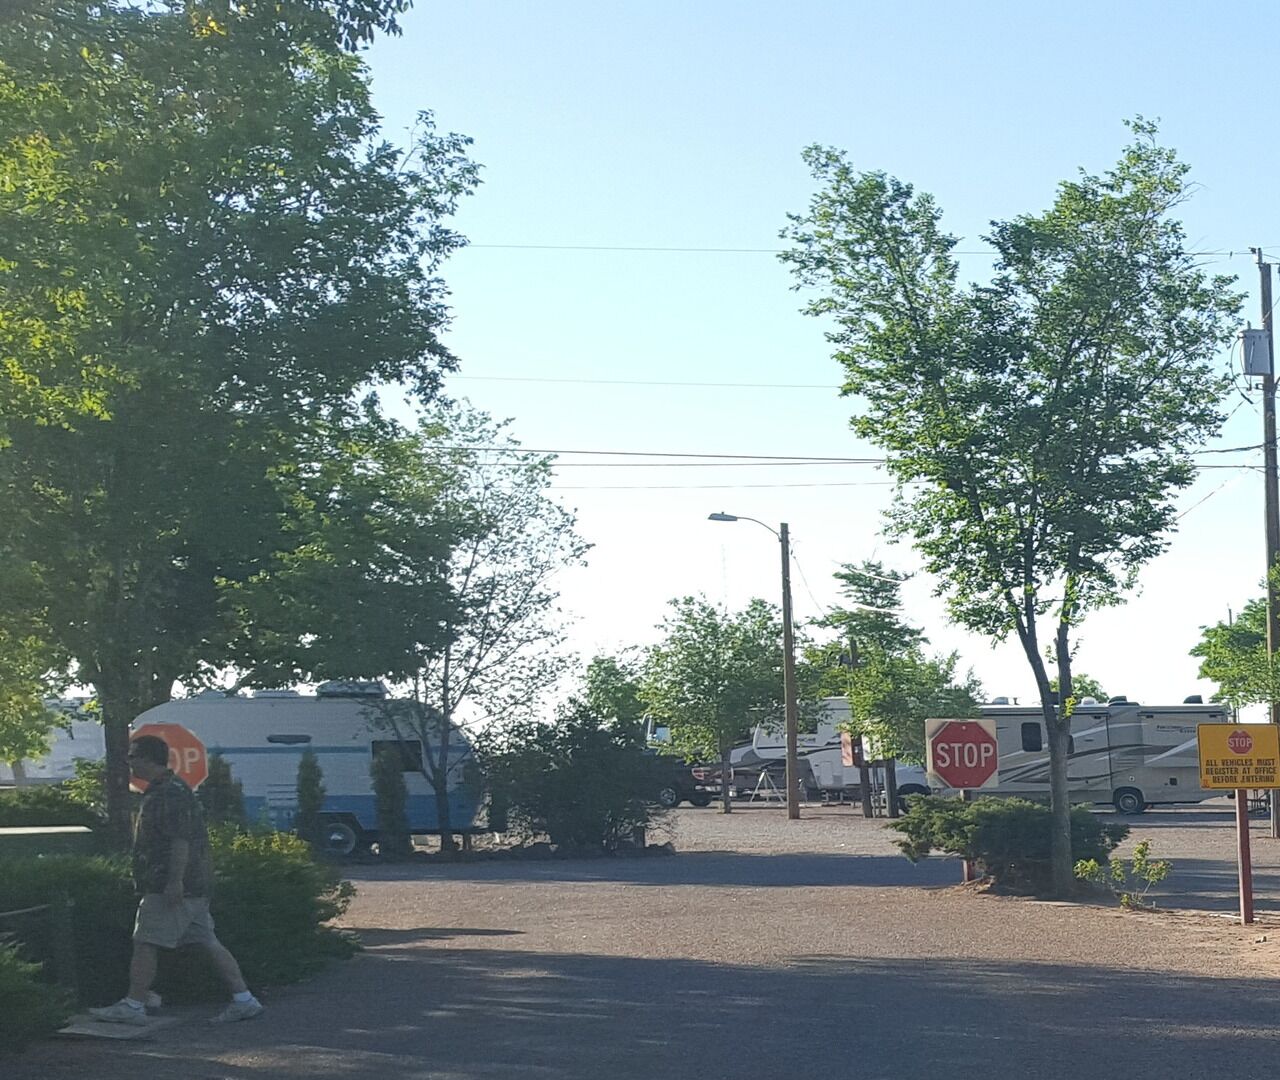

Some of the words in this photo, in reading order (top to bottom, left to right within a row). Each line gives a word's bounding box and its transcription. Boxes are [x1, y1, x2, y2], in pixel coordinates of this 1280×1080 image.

[1229, 737, 1252, 748] STOP
[936, 742, 994, 768] STOP
[167, 747, 200, 774] OP
[1205, 759, 1218, 767] ALL
[1221, 759, 1253, 767] VEHICLES
[1205, 767, 1238, 775] REGISTER
[1242, 767, 1250, 775] AT
[1254, 766, 1277, 775] OFFICE
[1212, 775, 1238, 784] BEFORE
